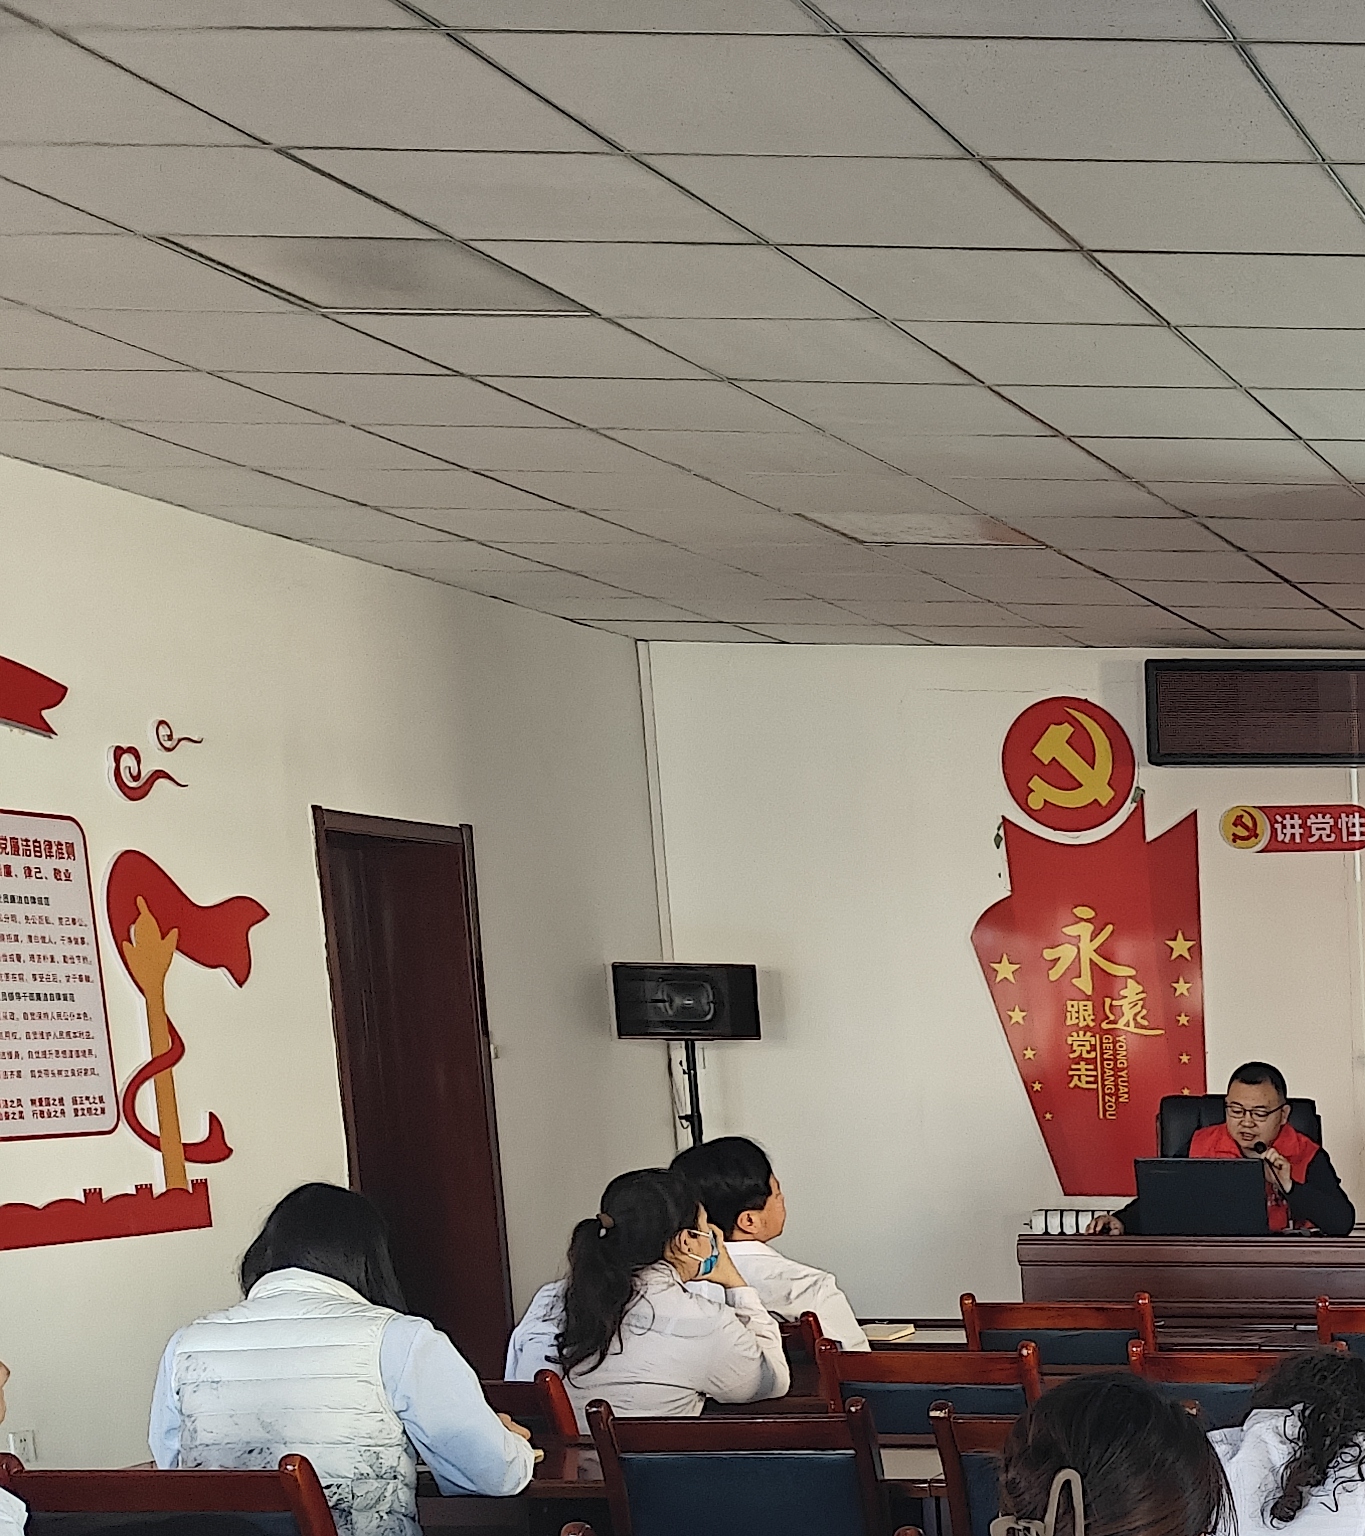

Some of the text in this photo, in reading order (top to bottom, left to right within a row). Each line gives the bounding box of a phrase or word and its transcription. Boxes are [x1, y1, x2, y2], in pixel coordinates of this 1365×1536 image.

[1065, 1000, 1099, 1090] 跟党走
[1102, 1034, 1117, 1120] GEN DANG ZOU
[1115, 1034, 1129, 1103] YONG YUAN
